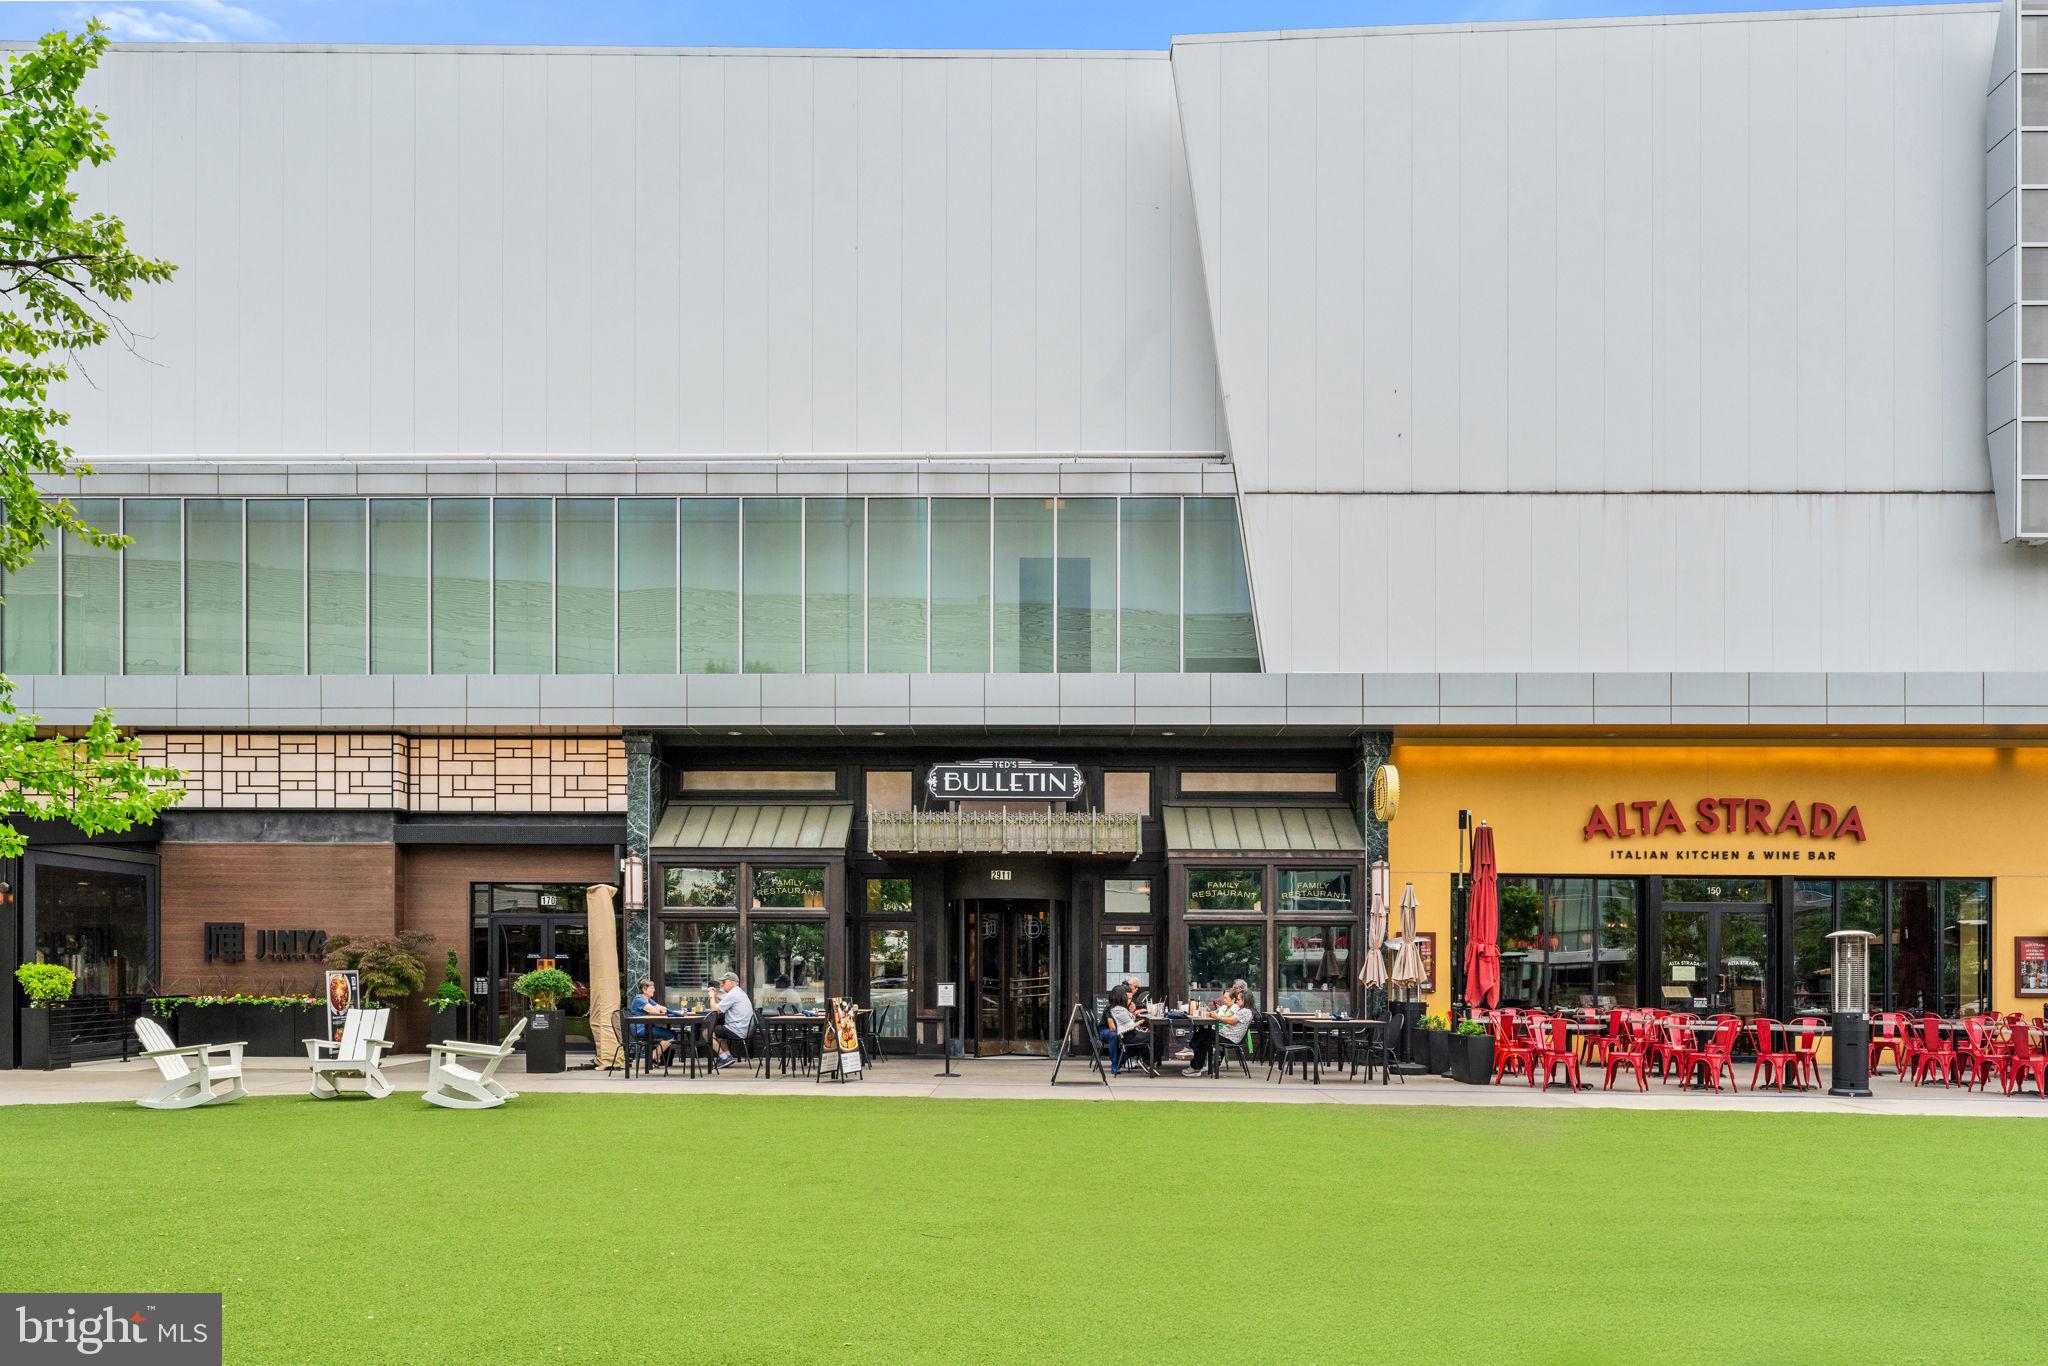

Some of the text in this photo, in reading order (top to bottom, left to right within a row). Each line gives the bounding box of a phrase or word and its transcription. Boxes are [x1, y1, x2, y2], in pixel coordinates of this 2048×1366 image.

[993, 761, 1017, 769] TED'S
[944, 772, 1067, 792] BULLETIN
[1584, 797, 1867, 842] ALTA STRADA
[1611, 850, 1838, 861] ITALIAN KITCHEN & WINE BAR
[991, 870, 1011, 880] 2911
[771, 878, 804, 888] FAMILY
[1207, 881, 1241, 889] FAMILY
[1296, 882, 1330, 890] FAMILY
[756, 887, 821, 898] RESTAURANT
[1191, 889, 1257, 899] RESTAURANT
[1281, 890, 1347, 900] RESTAURANT
[1707, 886, 1722, 896] 150
[541, 896, 556, 905] 170
